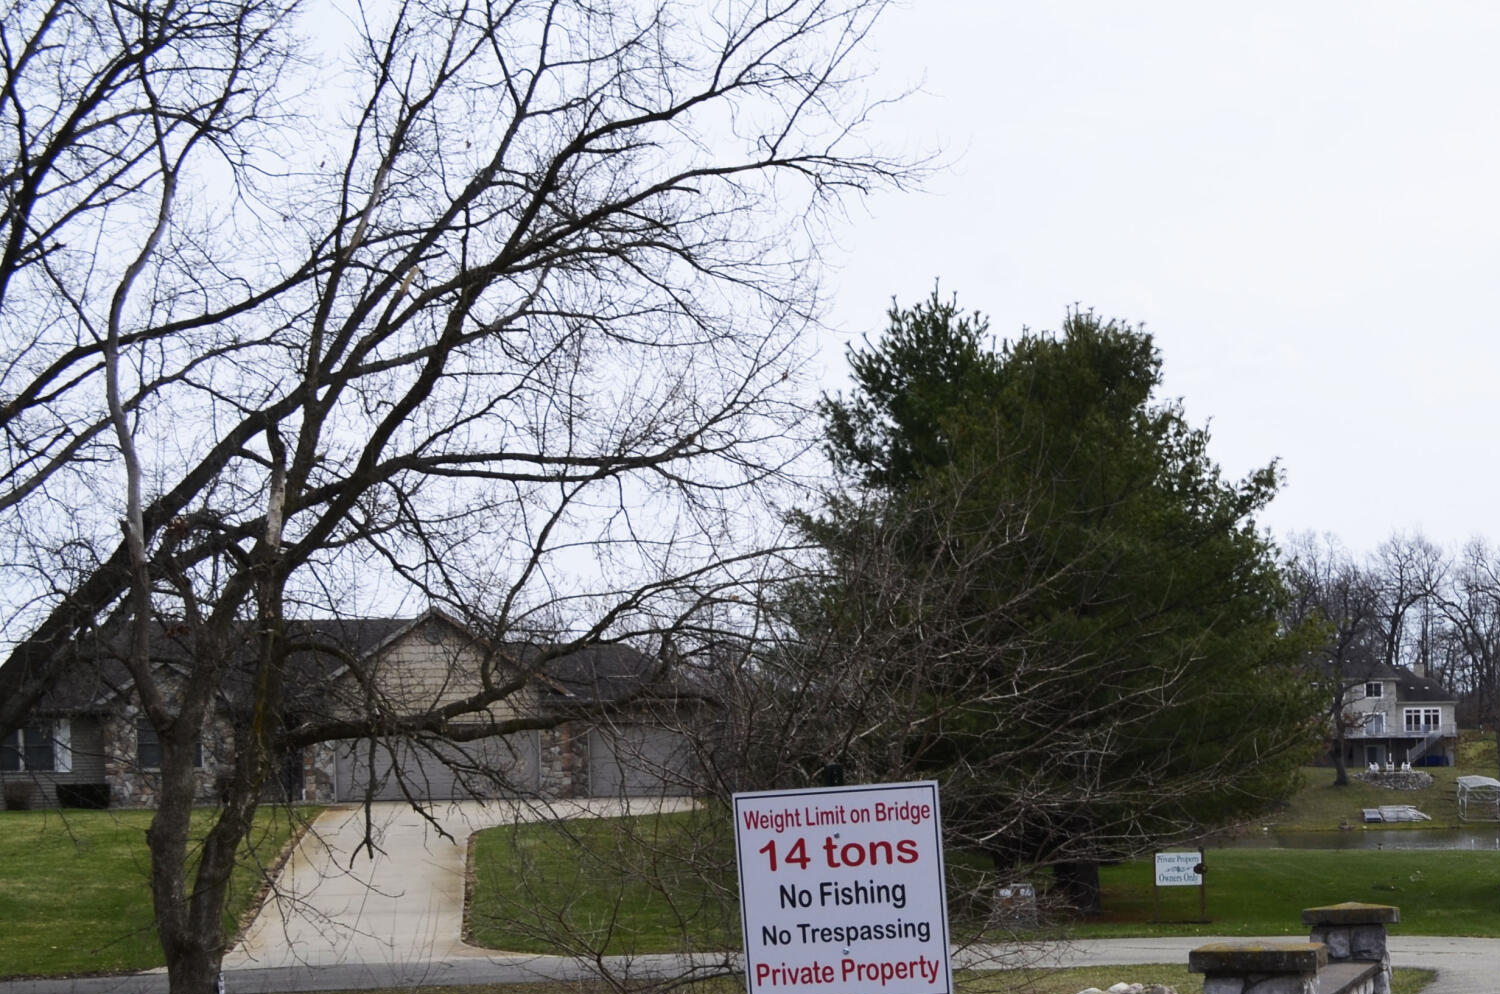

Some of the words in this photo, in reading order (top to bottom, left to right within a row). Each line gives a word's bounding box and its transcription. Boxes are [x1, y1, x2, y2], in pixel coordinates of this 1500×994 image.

[743, 807, 802, 834] Weight
[805, 805, 847, 827] Limit
[850, 807, 871, 824] on
[875, 800, 931, 825] Bridge
[759, 837, 811, 872] 14
[823, 836, 919, 869] tons
[1156, 855, 1175, 864] Private
[1159, 873, 1182, 882] Owners
[779, 884, 813, 909] No
[819, 880, 906, 909] Fishing
[762, 925, 792, 946] No
[797, 918, 931, 947] Trespassing
[756, 960, 835, 987] Private
[841, 955, 940, 987] Property
